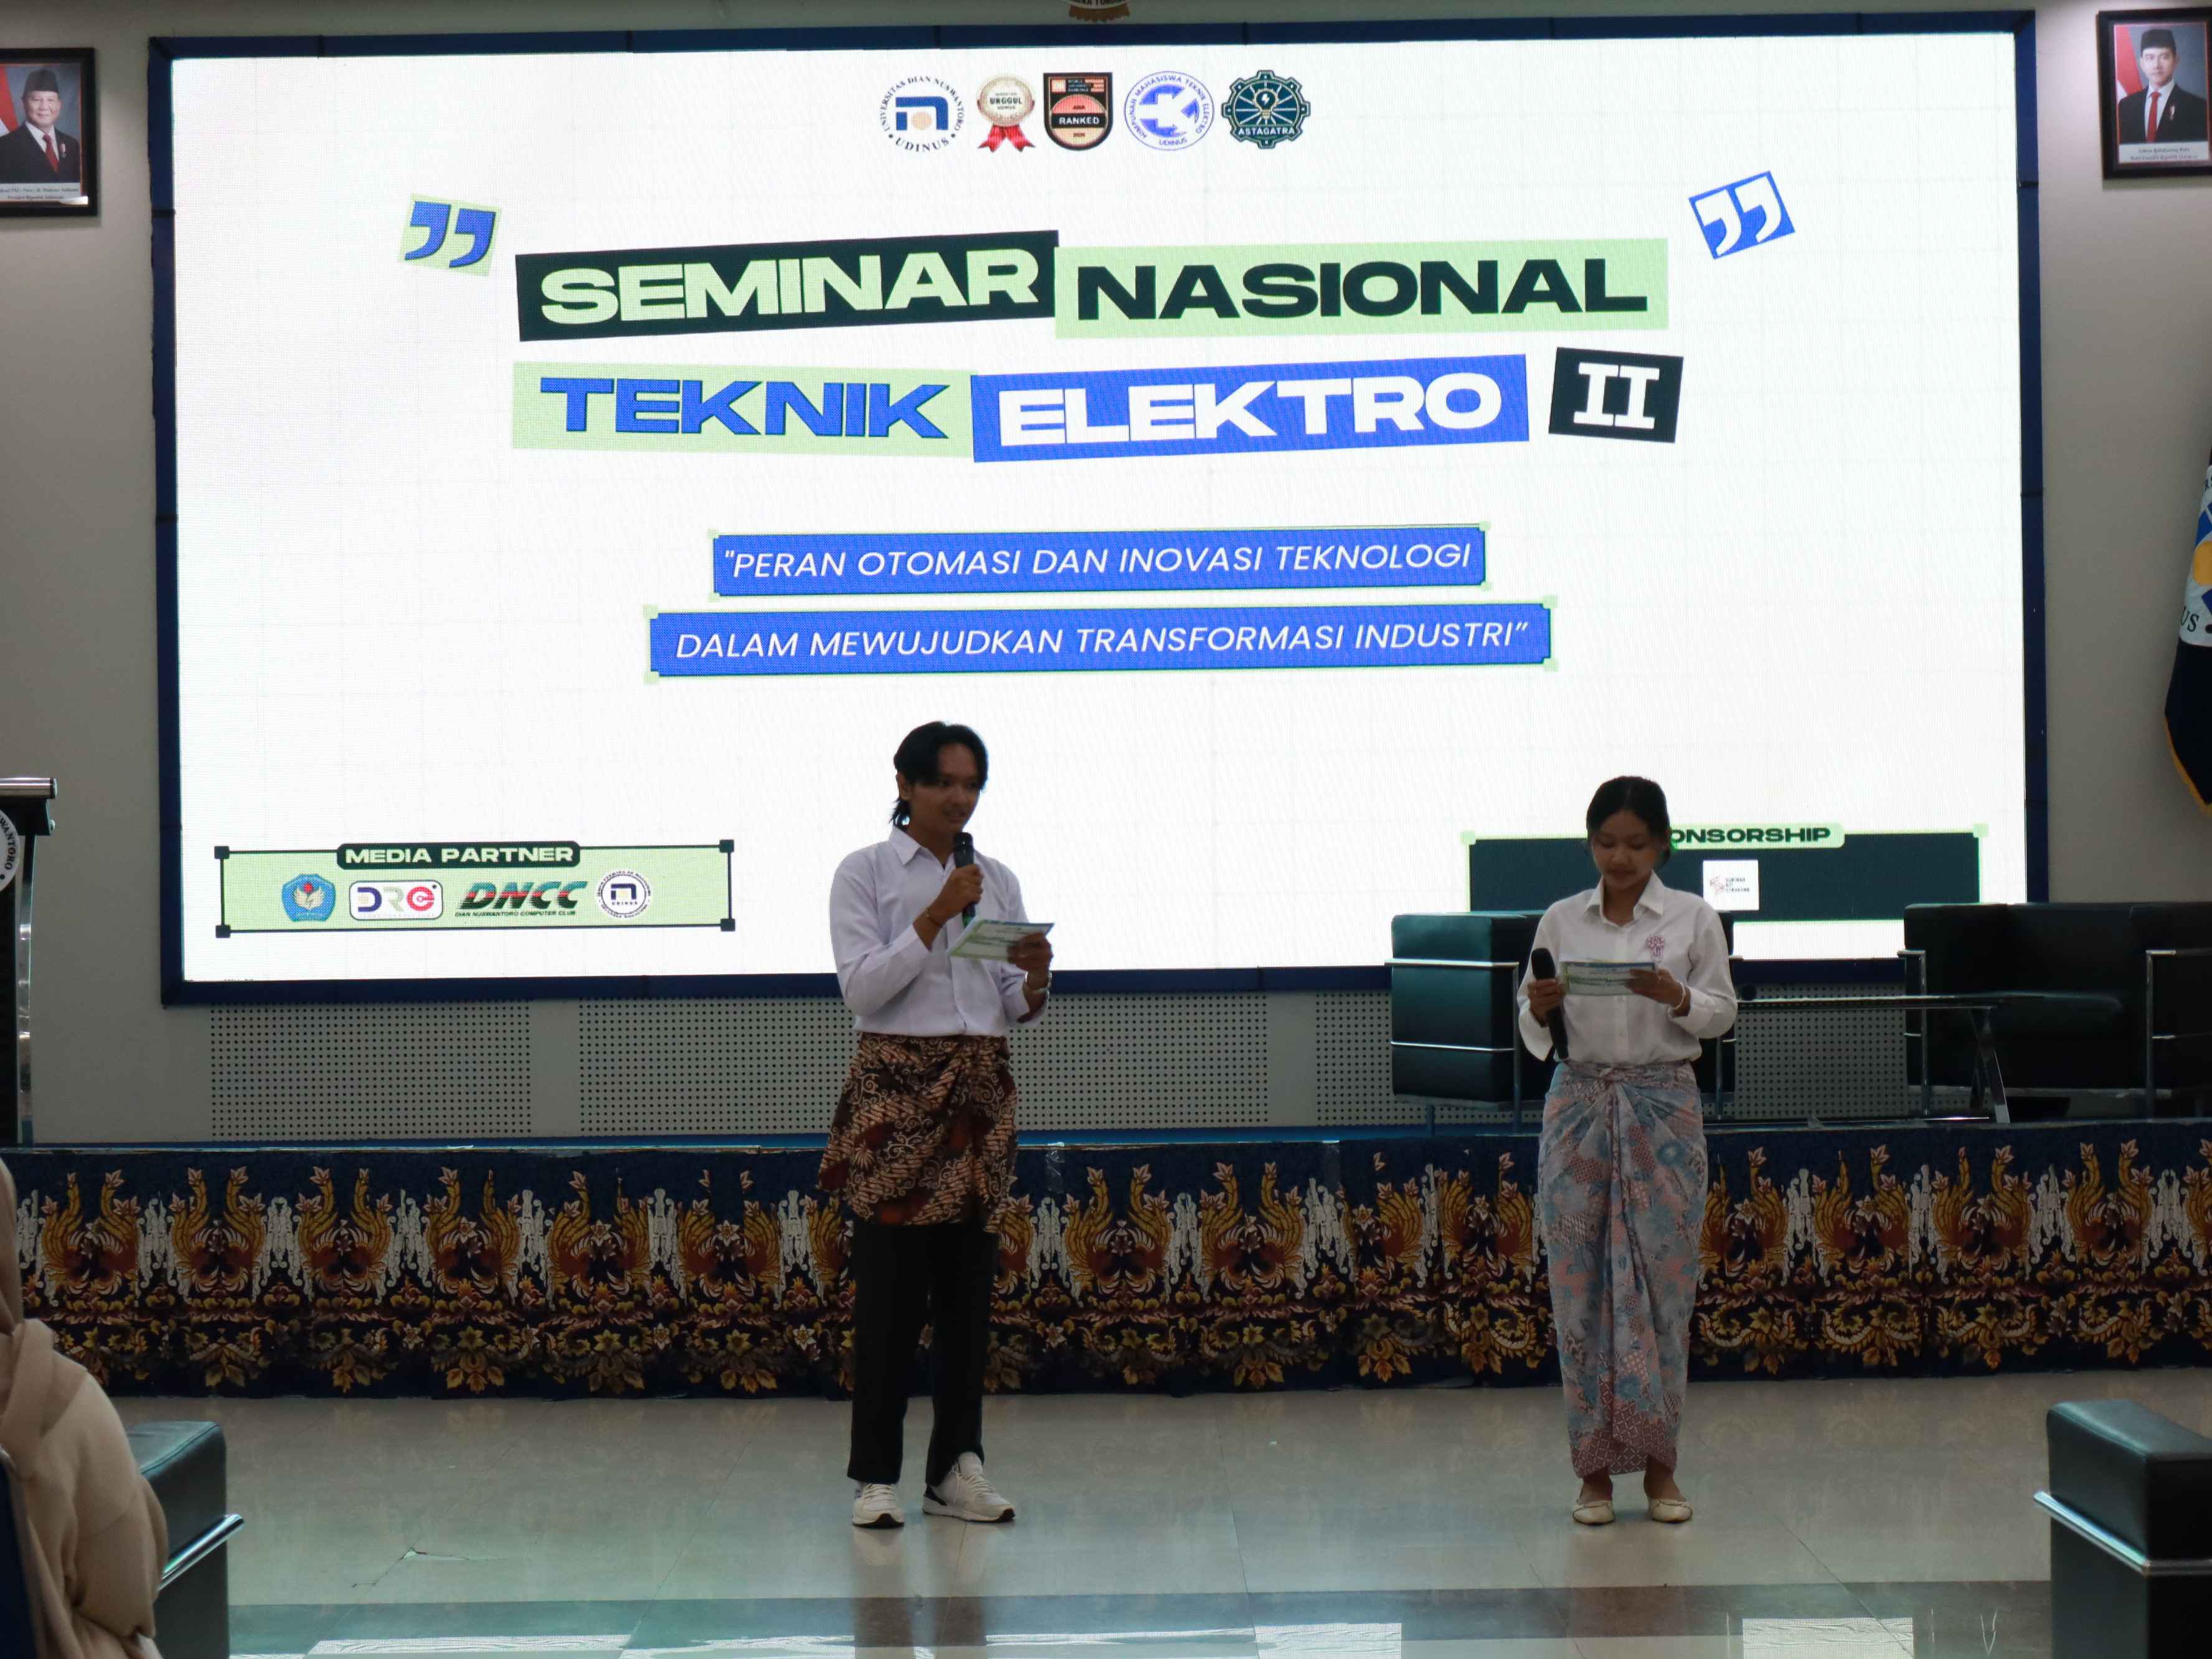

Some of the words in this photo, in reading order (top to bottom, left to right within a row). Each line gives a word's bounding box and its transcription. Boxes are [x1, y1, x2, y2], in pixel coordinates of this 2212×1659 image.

[1135, 75, 1181, 96] MAHASISWA
[880, 81, 905, 131] UNIVERSITAS
[1059, 116, 1100, 125] RANKED
[1238, 127, 1295, 135] ASTAGATRA
[896, 137, 949, 152] UDINUS
[541, 248, 1039, 325] SEMINAR
[1077, 258, 1648, 320] NASIONAL
[540, 377, 950, 440] TEKNIK
[998, 372, 1503, 447] ELEKTRO
[1572, 362, 1660, 430] II
[858, 550, 1019, 576] OTOMASI
[1033, 548, 1108, 575] DAN
[1118, 546, 1263, 574] INOVASI
[1276, 543, 1471, 571] TEKNOLOGI
[676, 632, 799, 658] DALAM
[809, 628, 1064, 657] MEWUJUDKAN
[1075, 625, 1344, 653] TRANSFORMASI
[0, 817, 16, 870] WANTORO
[1670, 827, 1832, 843] ONSORSHIP
[345, 848, 432, 864] MEDIA
[440, 847, 574, 863] PARTNER
[458, 881, 588, 909] DNCC
